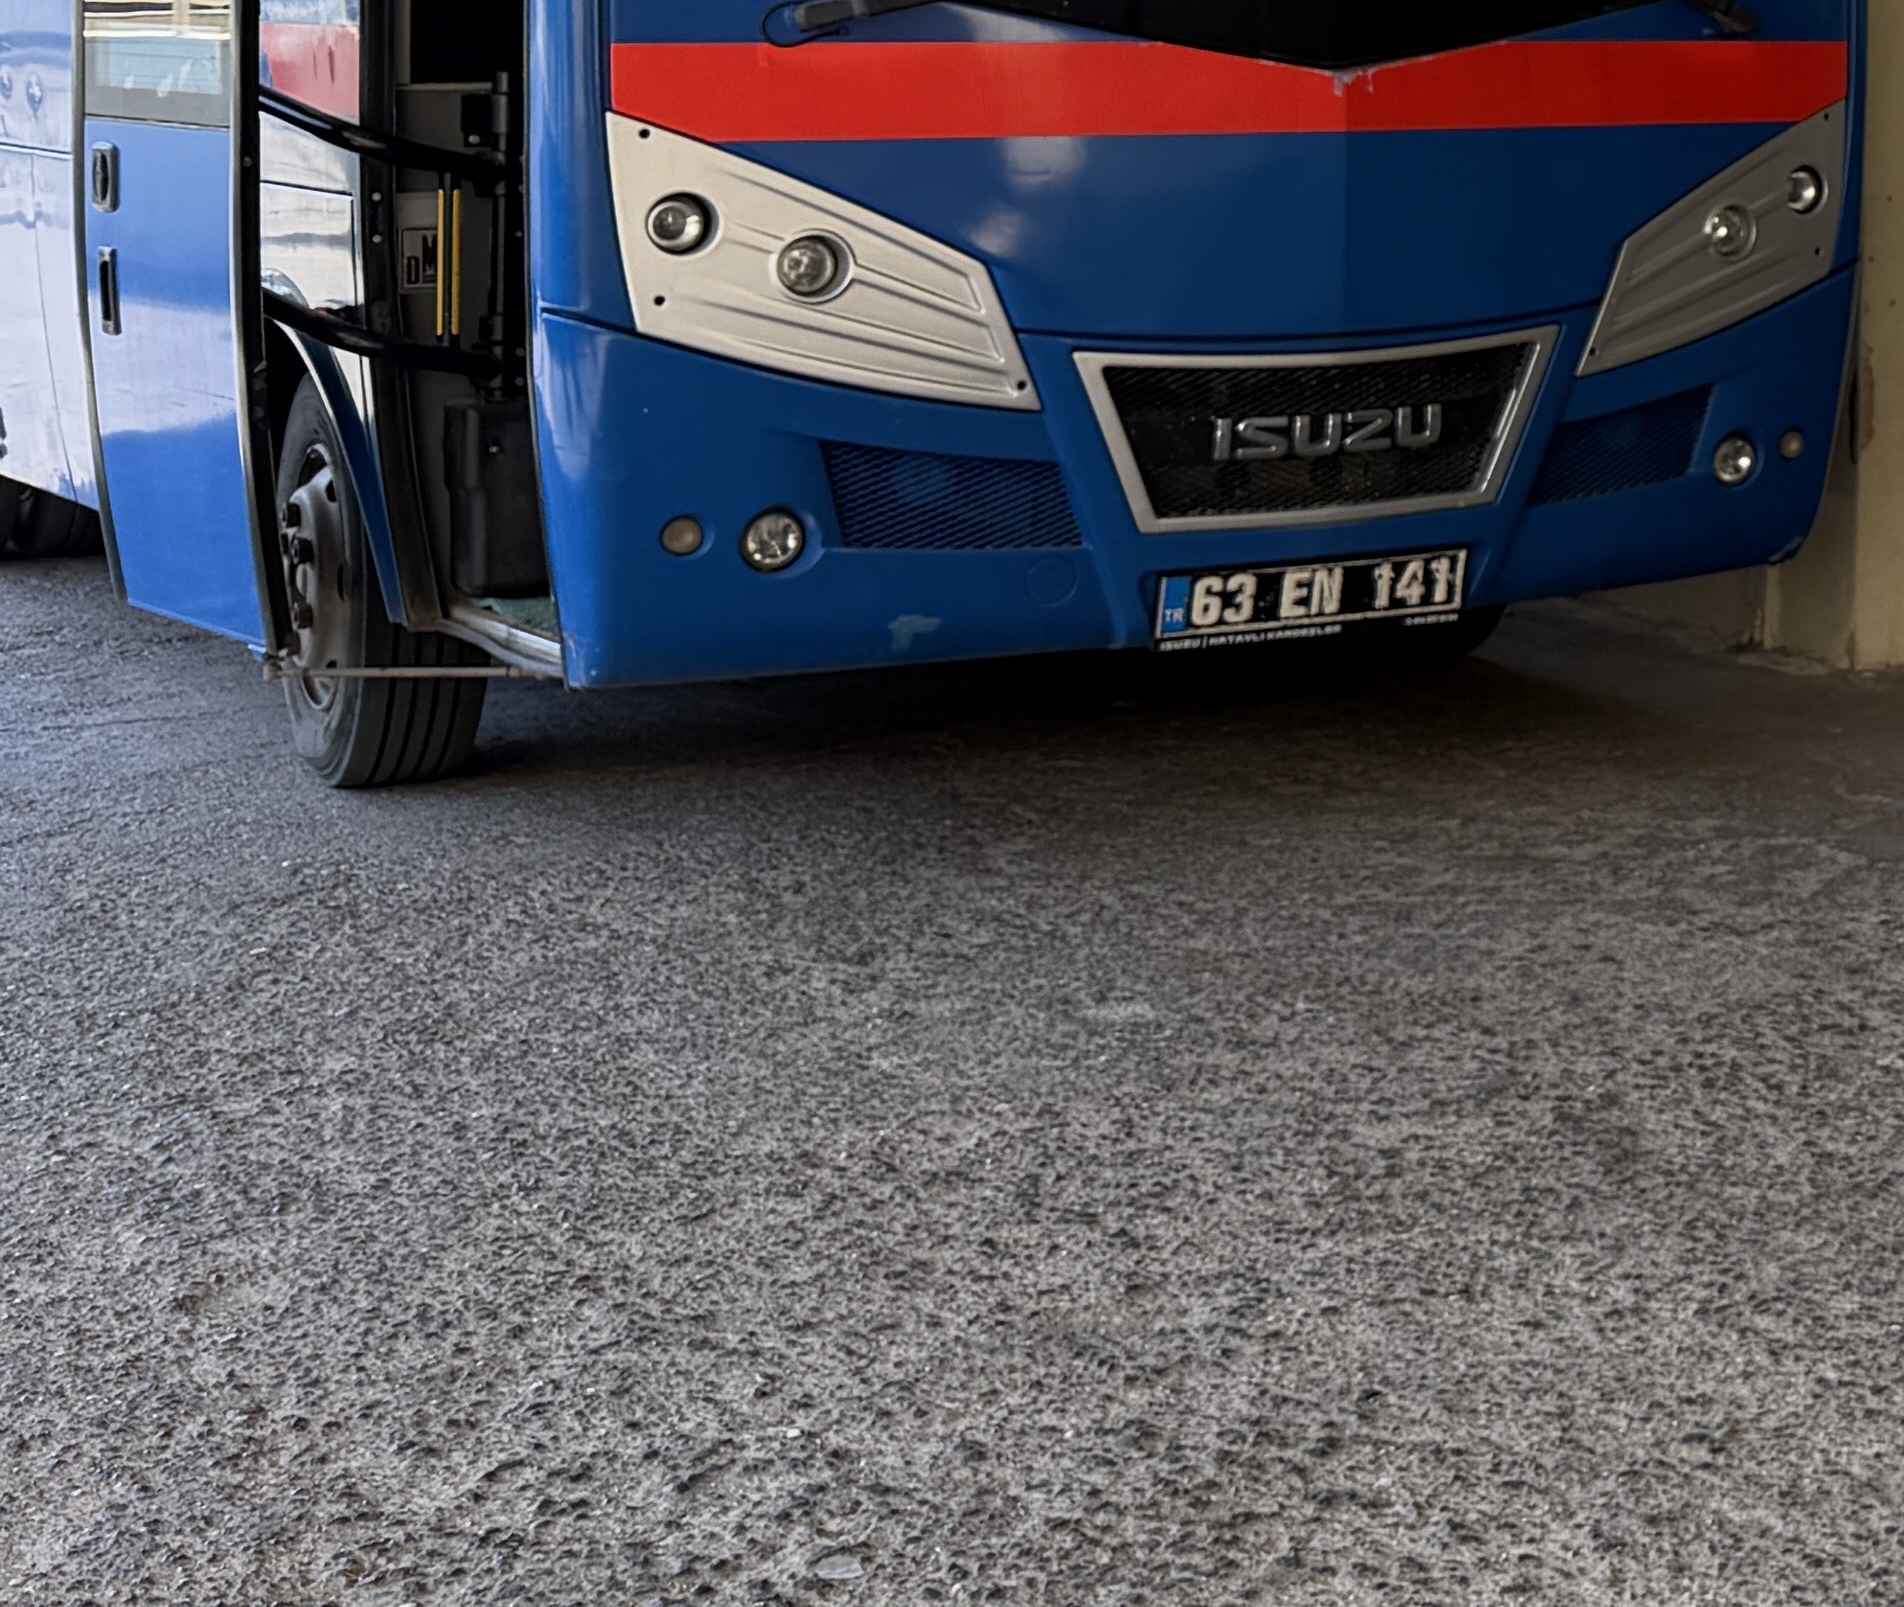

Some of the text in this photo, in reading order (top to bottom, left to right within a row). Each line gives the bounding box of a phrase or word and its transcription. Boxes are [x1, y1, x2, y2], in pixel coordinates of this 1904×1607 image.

[1210, 402, 1442, 461] ISUZU
[1165, 607, 1184, 623] TR
[1190, 555, 1450, 626] 63 EN 141
